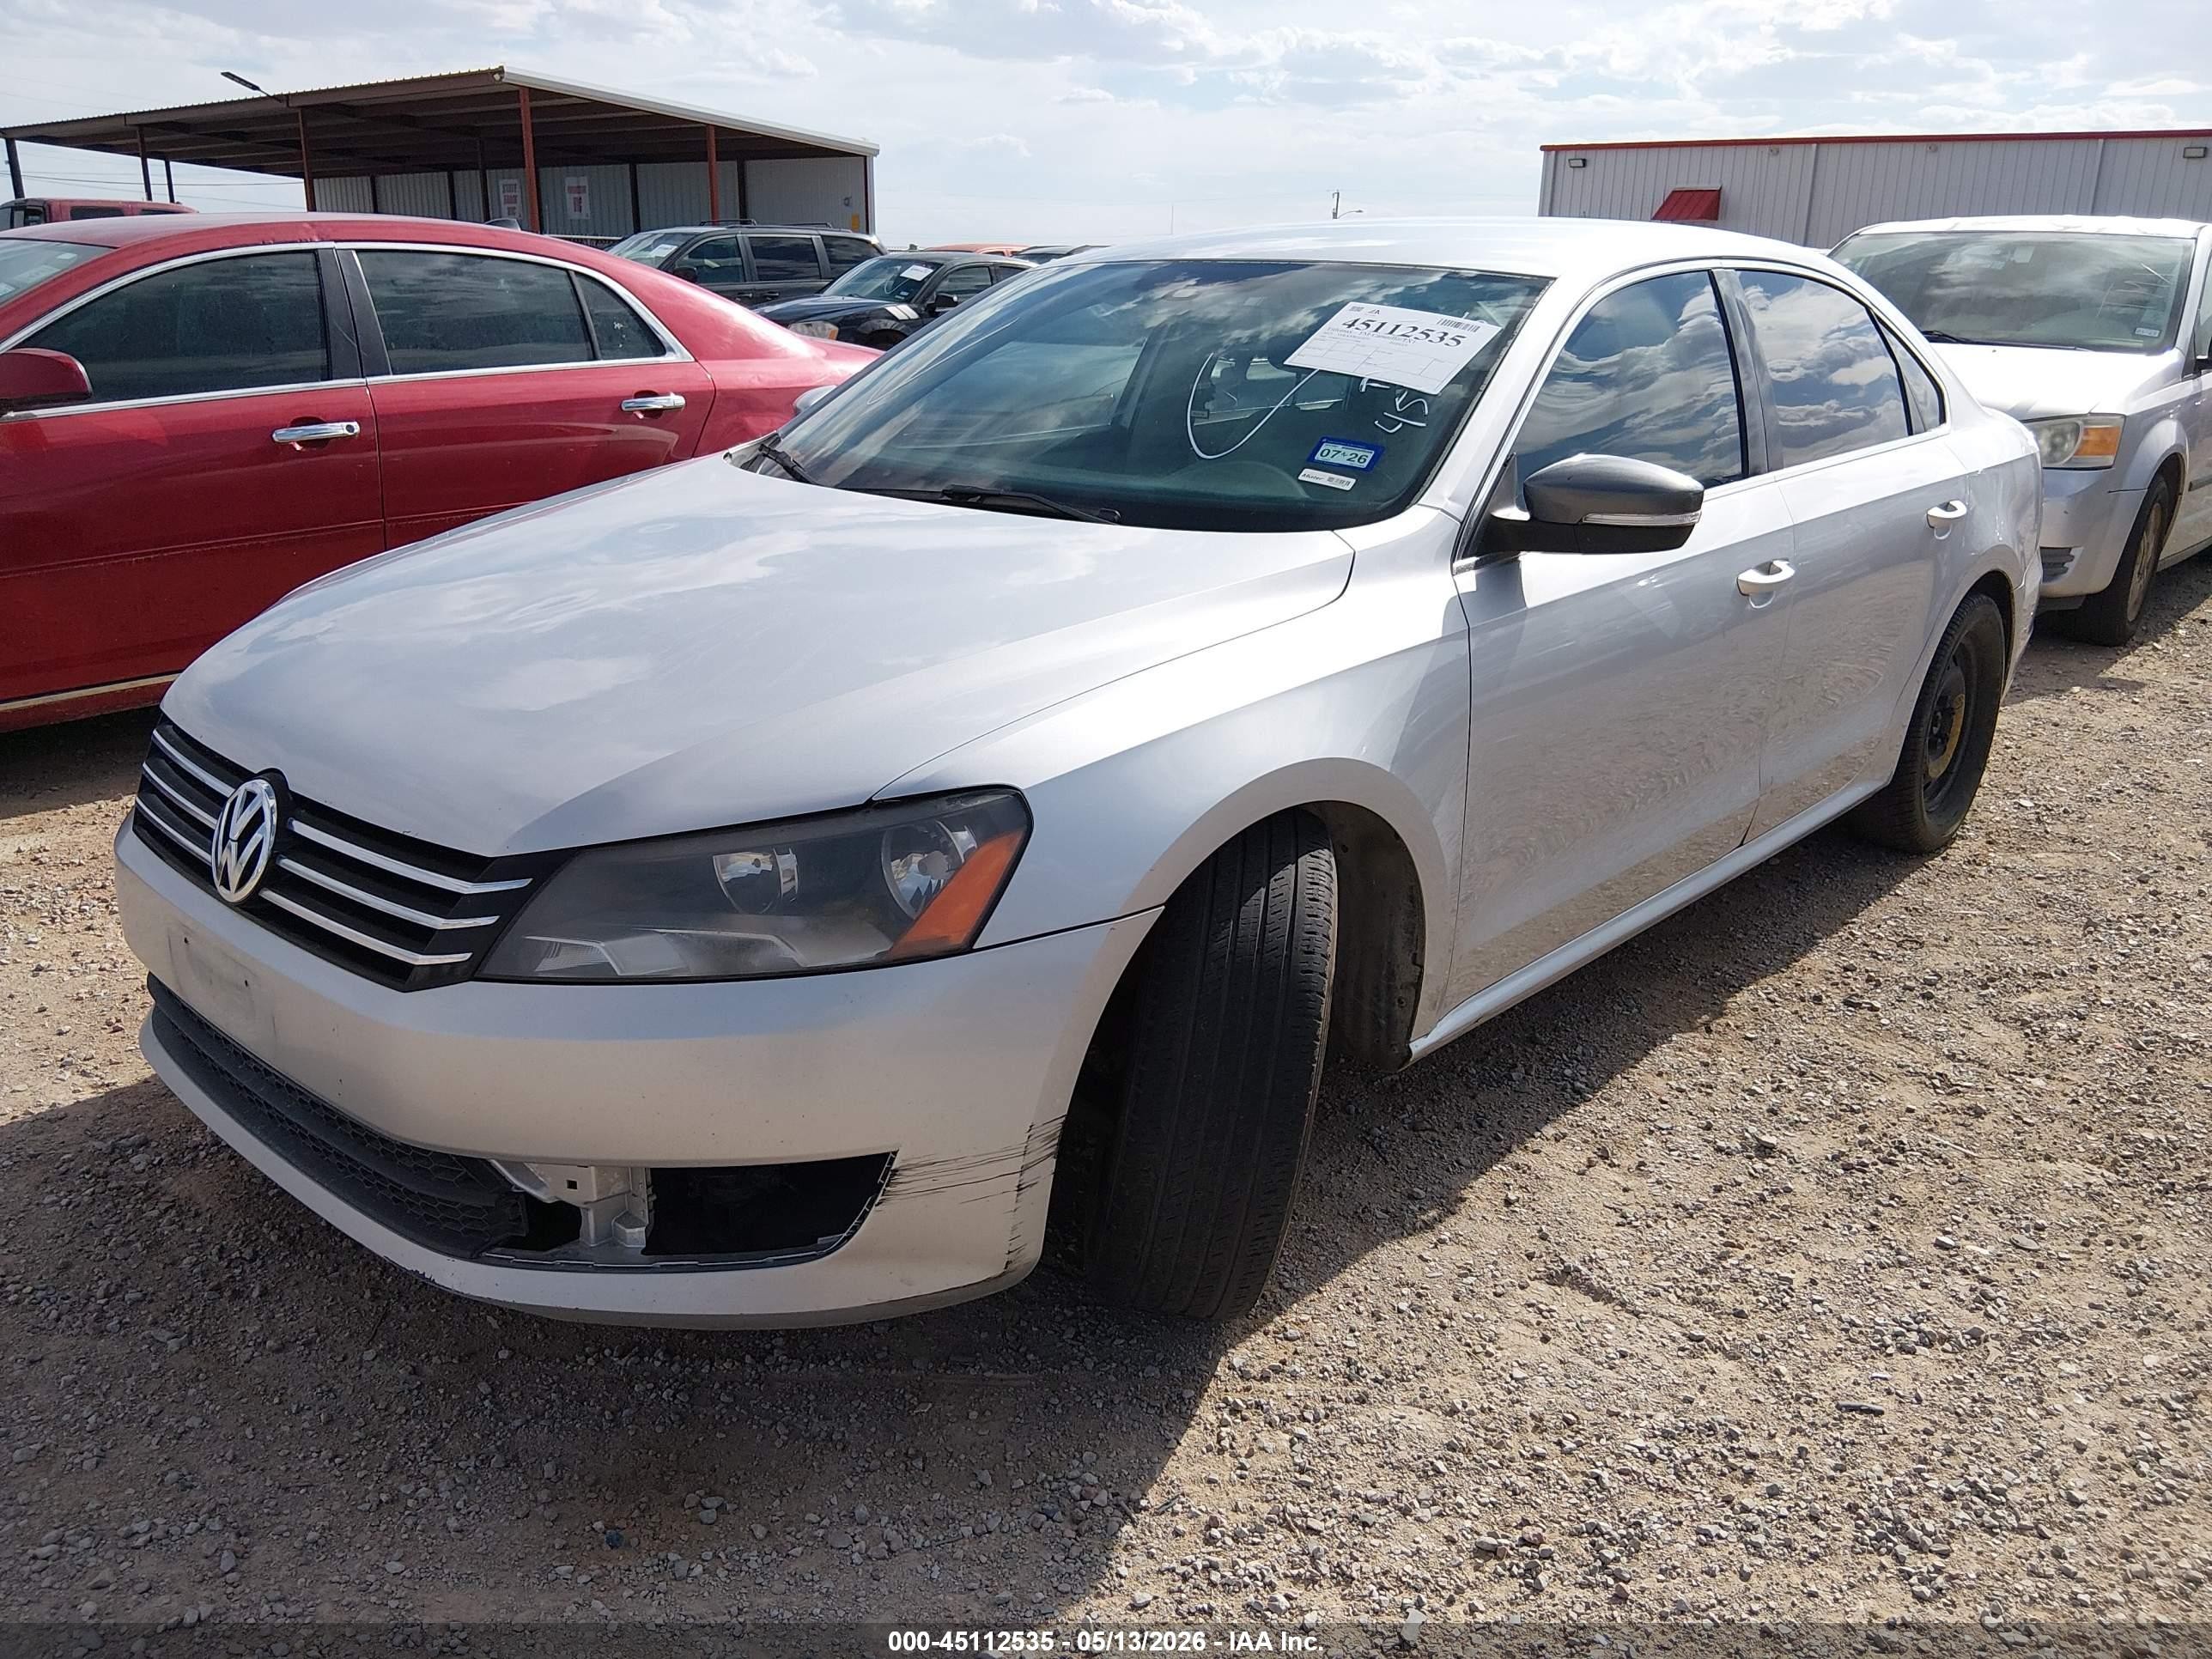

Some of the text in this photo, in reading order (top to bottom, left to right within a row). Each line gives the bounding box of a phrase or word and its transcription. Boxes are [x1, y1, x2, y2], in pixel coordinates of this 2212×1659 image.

[1341, 318, 1467, 347] 45112535
[1320, 448, 1369, 464] 07 26
[215, 781, 275, 900] VW
